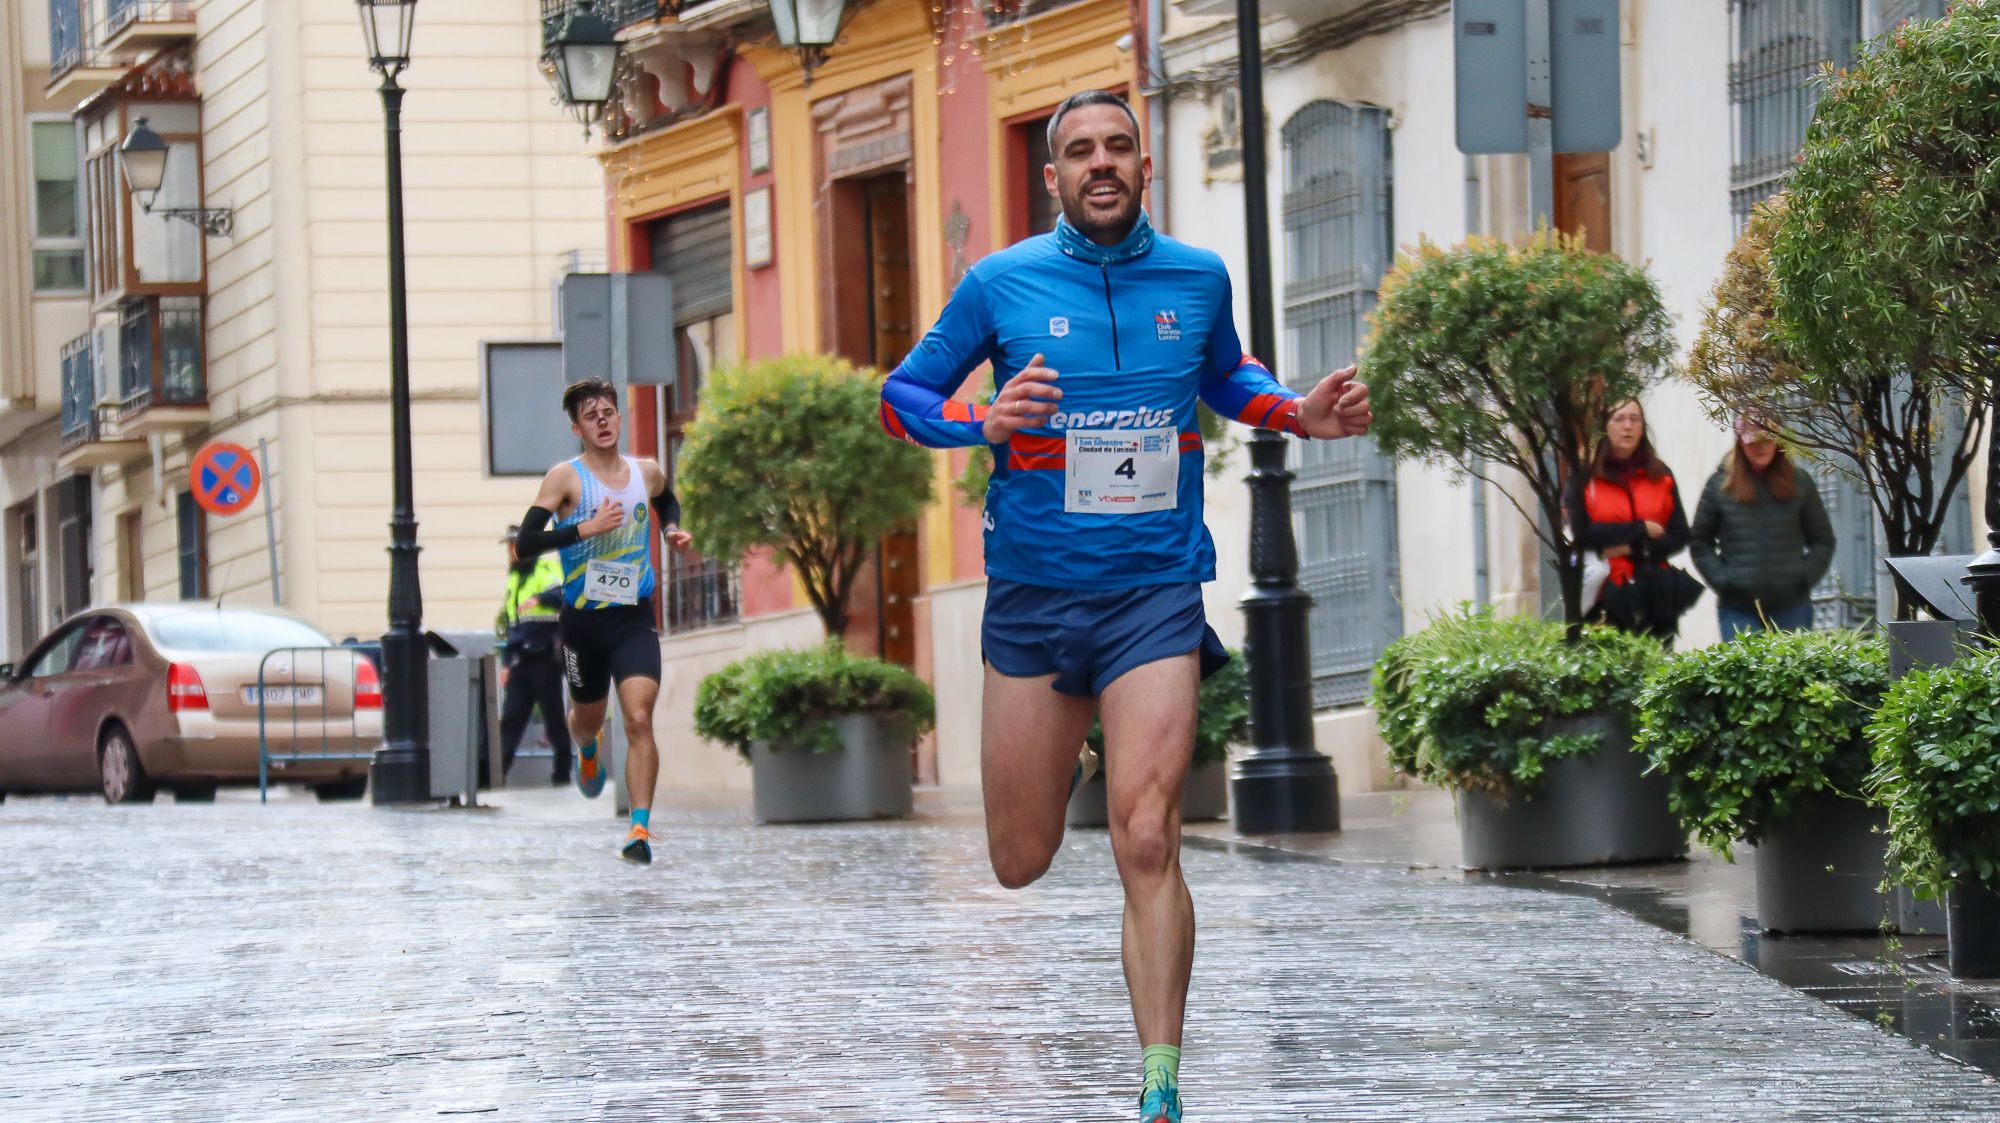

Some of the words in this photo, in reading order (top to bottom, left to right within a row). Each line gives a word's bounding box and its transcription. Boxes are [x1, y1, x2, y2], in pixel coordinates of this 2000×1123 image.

[1049, 405, 1174, 431] enerplus
[1114, 457, 1136, 480] 4
[597, 574, 630, 588] 470
